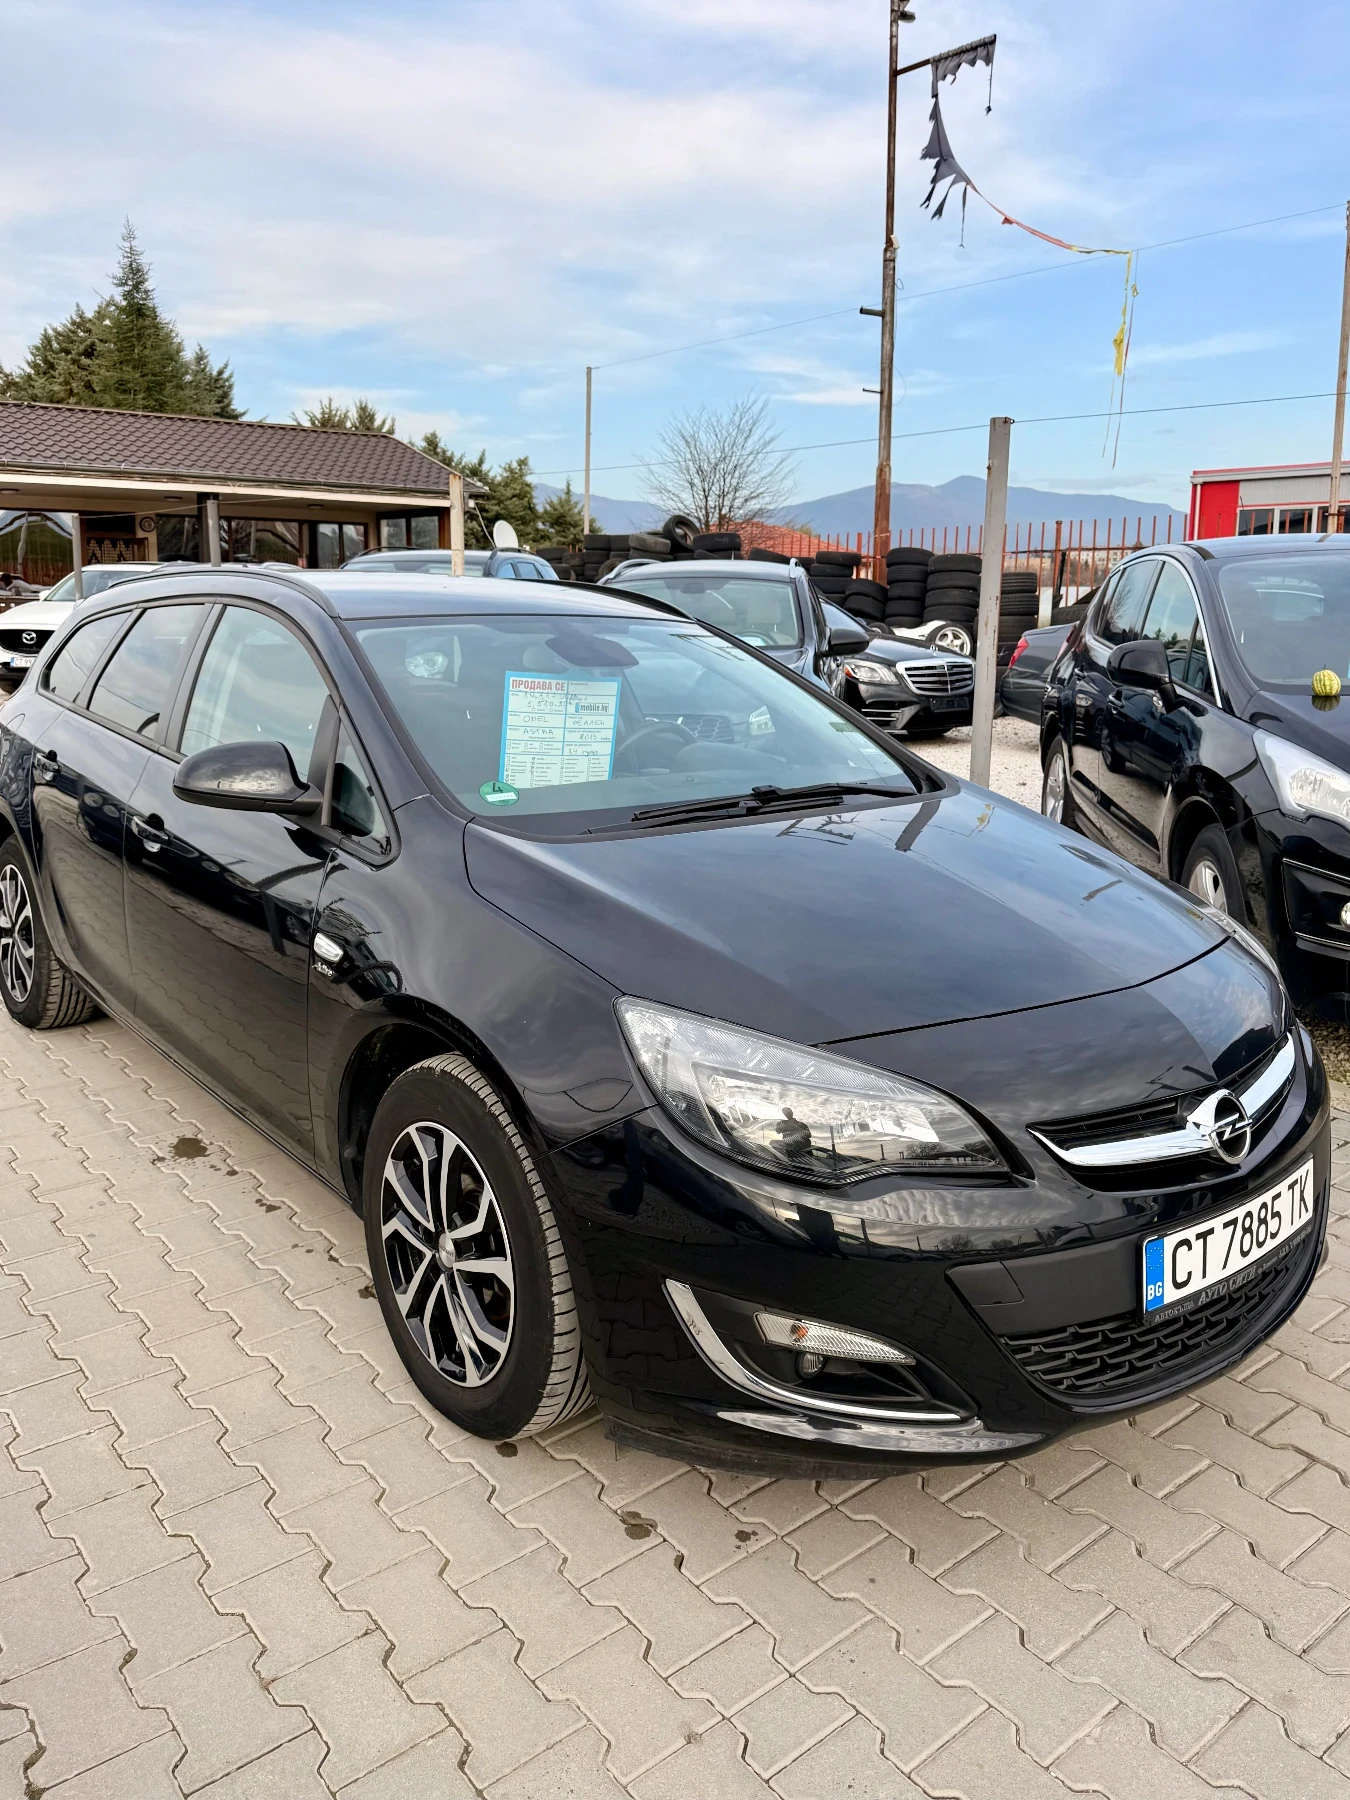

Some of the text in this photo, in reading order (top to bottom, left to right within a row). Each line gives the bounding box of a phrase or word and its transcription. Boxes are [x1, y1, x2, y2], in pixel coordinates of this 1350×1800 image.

[512, 680, 565, 691] ПРОДАВА СЕ
[580, 703, 608, 713] mobile.bg
[1171, 1227, 1215, 1290] CT
[1222, 1191, 1282, 1271] 7885
[1288, 1169, 1309, 1227] TK
[1147, 1281, 1163, 1301] BG
[1197, 1281, 1228, 1306] АУТО
[1229, 1265, 1256, 1291] СИТИ
